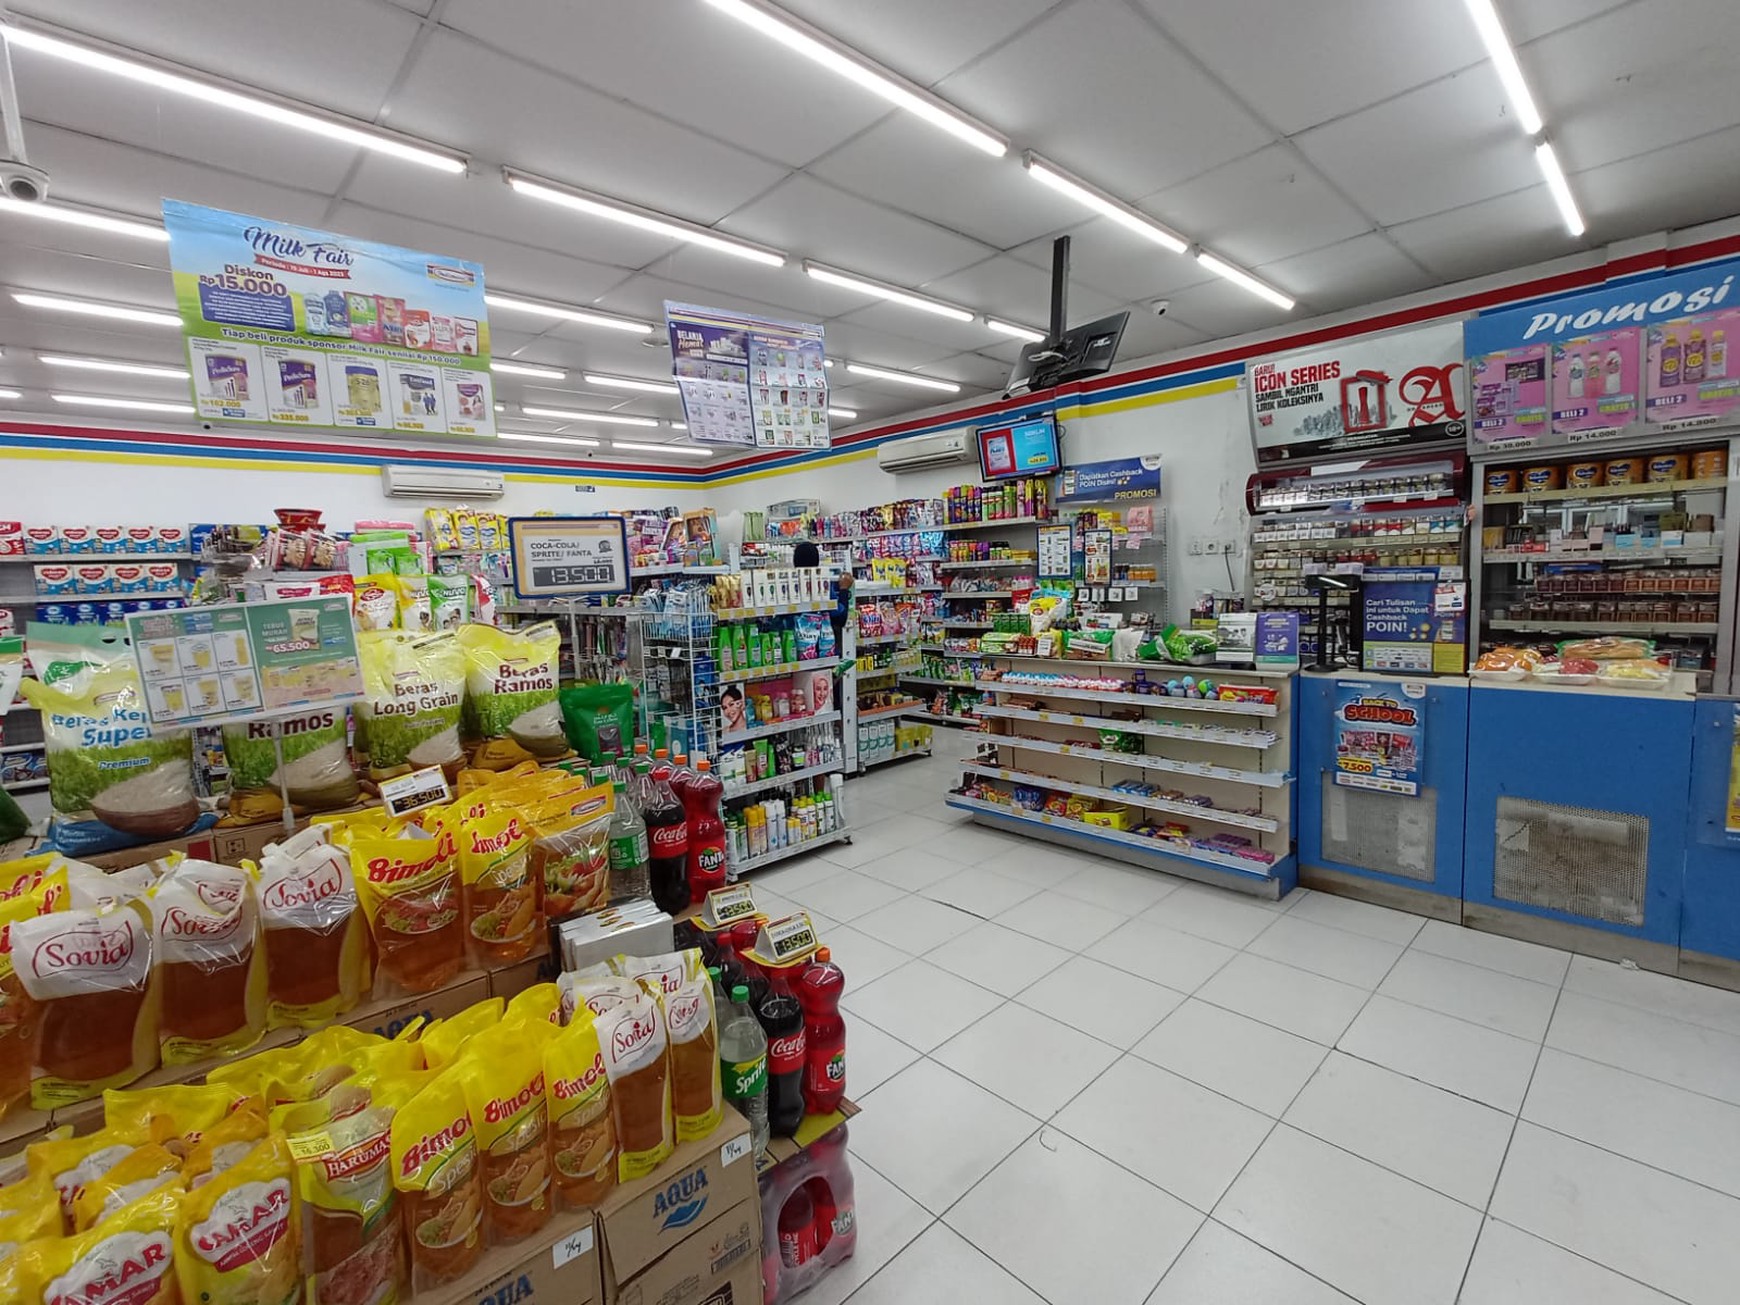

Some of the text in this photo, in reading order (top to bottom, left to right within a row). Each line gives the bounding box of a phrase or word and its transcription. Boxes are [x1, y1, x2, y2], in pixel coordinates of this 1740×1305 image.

[244, 227, 354, 266] Milk Fair
[224, 264, 274, 281] Diskon
[200, 274, 287, 297] Rp 15.000
[1523, 275, 1735, 340] Promosi
[222, 328, 246, 340] Tiap
[247, 331, 267, 341] beli
[269, 335, 305, 346] produk
[307, 340, 346, 350] sponsor
[349, 342, 367, 352] Milk
[369, 346, 385, 355] Fair
[1254, 360, 1341, 393] ICON SERIES
[1285, 383, 1319, 398] NGANTRI
[1276, 392, 1324, 409] KOLEKSINYA
[1655, 395, 1683, 406] BELI 2
[1560, 407, 1585, 419] BELI 2
[1481, 420, 1498, 428] BELI
[1569, 430, 1617, 442] Rp 14.000
[1079, 468, 1143, 481] Dapatkan Cashback
[1114, 488, 1157, 500] PROMOSI
[551, 566, 610, 584] 13.500
[1378, 606, 1403, 614] untuk
[1404, 606, 1429, 614] Dapat
[1366, 621, 1408, 633] POIN!
[273, 641, 310, 653] 65.500
[394, 682, 437, 697] Beras
[494, 678, 553, 695] Ramos
[374, 693, 459, 716] Long Grain
[1345, 705, 1415, 725] SCHOOL
[99, 757, 150, 770] Premium
[45, 942, 128, 968] Sovia
[653, 1167, 709, 1219] AQUA
